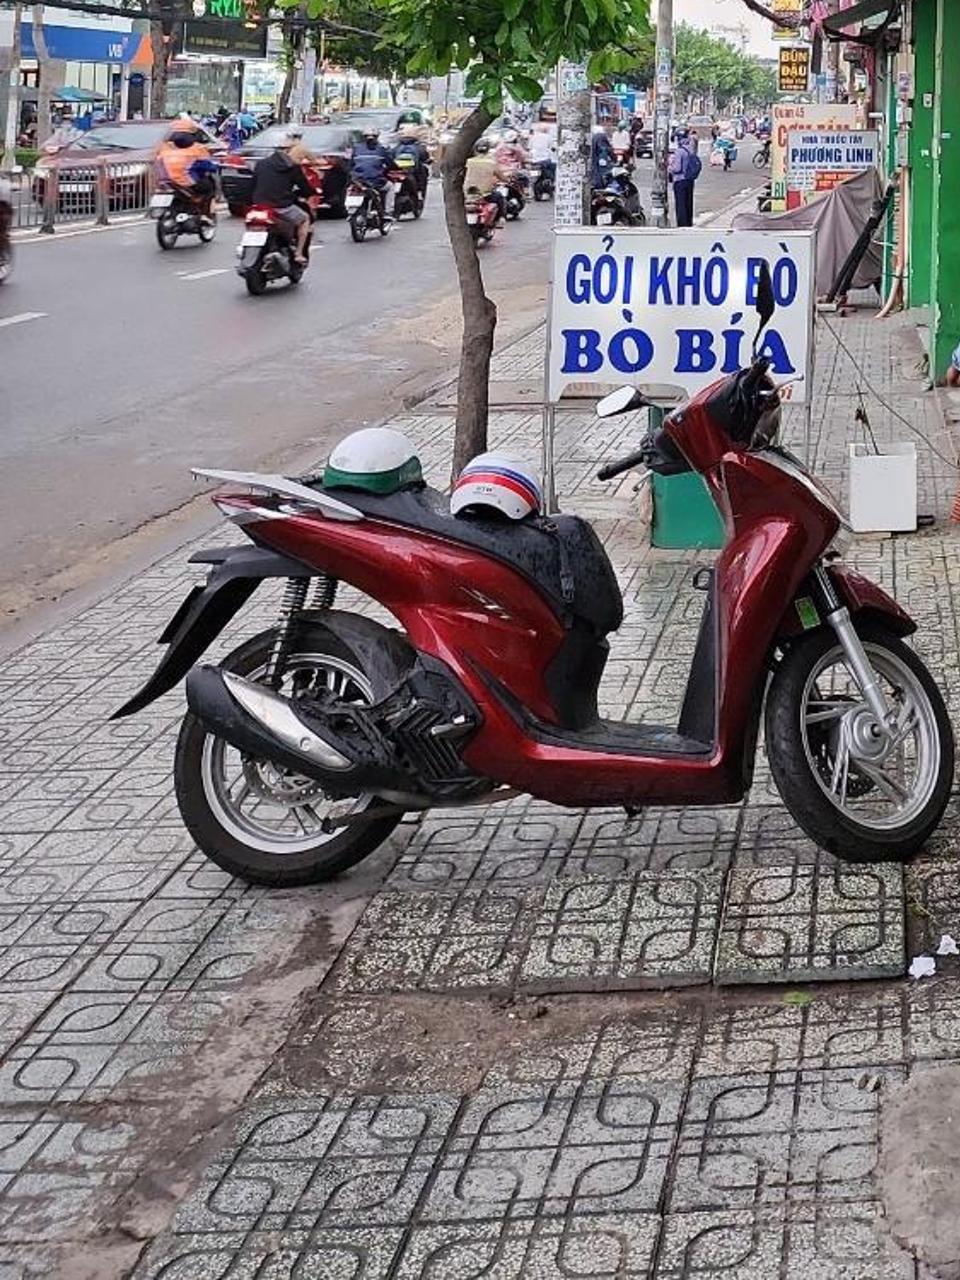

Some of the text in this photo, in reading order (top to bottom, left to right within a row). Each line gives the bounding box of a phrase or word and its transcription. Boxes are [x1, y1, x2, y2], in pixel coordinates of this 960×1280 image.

[846, 148, 873, 163] LINH
[565, 234, 634, 305] GỎI
[648, 242, 730, 306] KHÔ
[561, 308, 797, 375] BÒ BÍA
